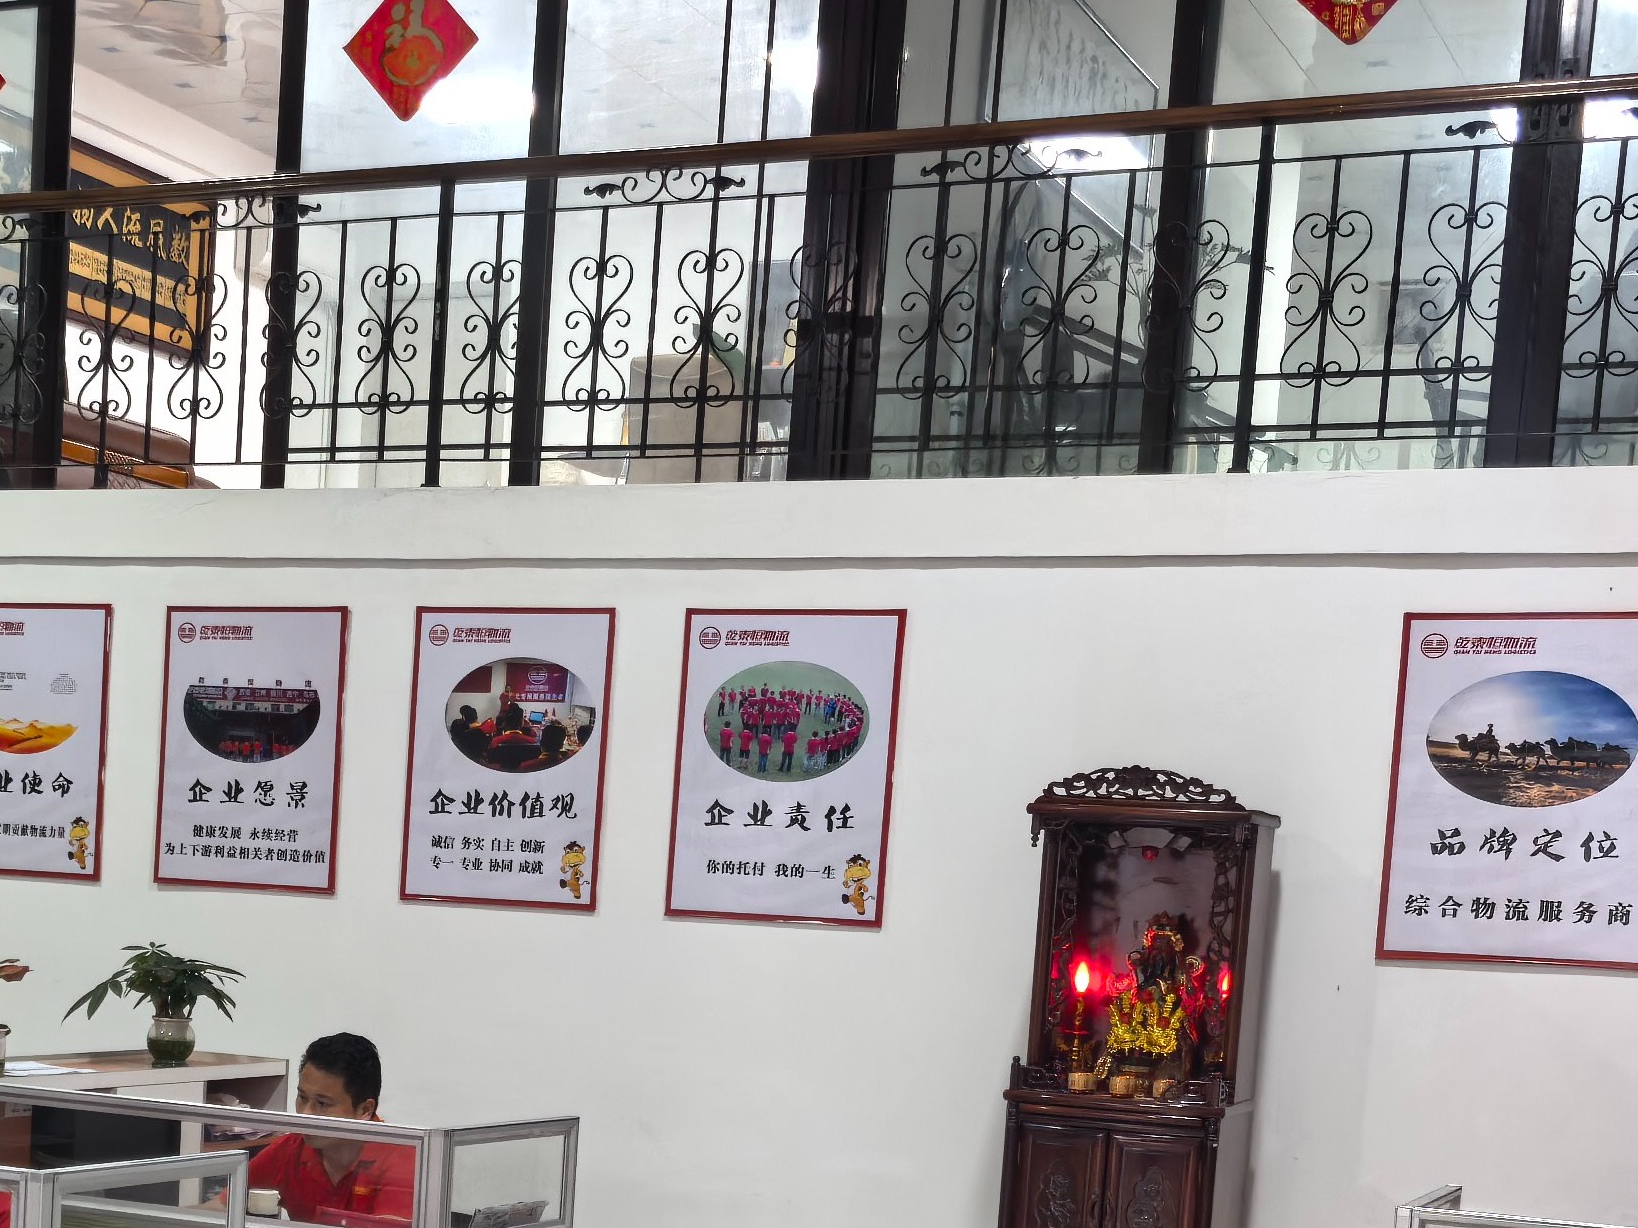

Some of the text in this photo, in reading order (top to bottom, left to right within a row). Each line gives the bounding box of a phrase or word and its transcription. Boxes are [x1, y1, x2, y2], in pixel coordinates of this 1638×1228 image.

[188, 778, 309, 809] 企业愿景
[428, 788, 578, 819] 企业价值观
[704, 799, 855, 833] 企业责任
[192, 824, 299, 843] 健康发展 永续经营
[431, 834, 546, 854] 诚信 务实 自主 创新
[1429, 826, 1620, 862] 品牌定位
[164, 842, 326, 864] 为上下游利益相关者创造价值
[430, 855, 544, 875] 专一 专业 协同 成就
[706, 859, 837, 880] 你的托付 我的一生
[1403, 894, 1633, 926] 综合物流服务商
